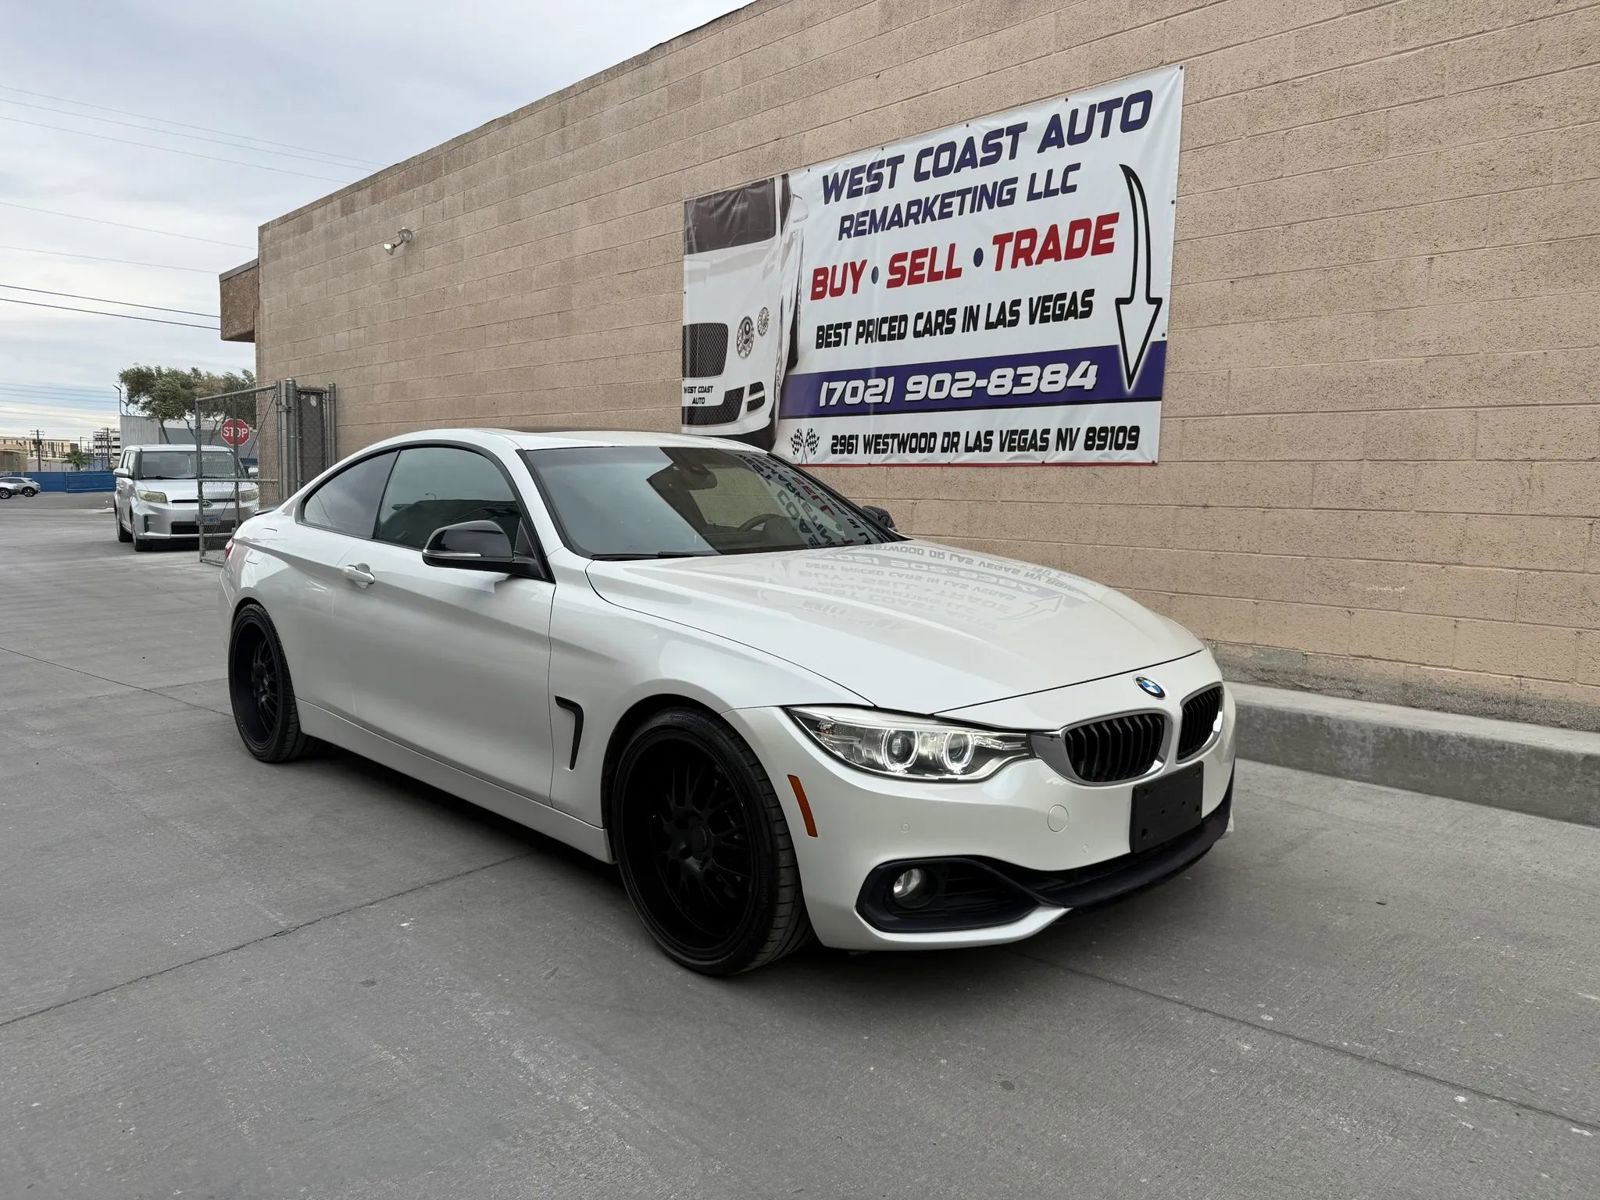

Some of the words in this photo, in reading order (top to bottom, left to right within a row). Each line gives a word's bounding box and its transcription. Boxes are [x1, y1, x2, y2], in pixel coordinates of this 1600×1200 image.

[822, 154, 905, 204] WEST
[913, 121, 1028, 182] COAST
[1036, 89, 1153, 154] AUTO
[838, 177, 1018, 241] REMARKETING
[1026, 163, 1081, 202] LLC
[810, 259, 868, 301] BUY
[886, 243, 962, 288] SELL
[992, 212, 1120, 272] TRADE
[815, 321, 851, 349] BEST
[855, 314, 908, 345] PRICED
[913, 307, 956, 338] CARS
[961, 304, 981, 333] IN
[984, 299, 1022, 330] LAS
[1028, 288, 1095, 325] VEGAS
[819, 376, 894, 407] (702)
[904, 360, 1098, 401] 902-8384
[830, 434, 858, 455] 2961
[862, 431, 938, 455] WESTWOOD
[940, 430, 959, 453] DR
[964, 429, 993, 452] LAS
[999, 427, 1050, 452] VEGAS
[1055, 427, 1081, 451] NV
[1083, 425, 1140, 451] 89109
